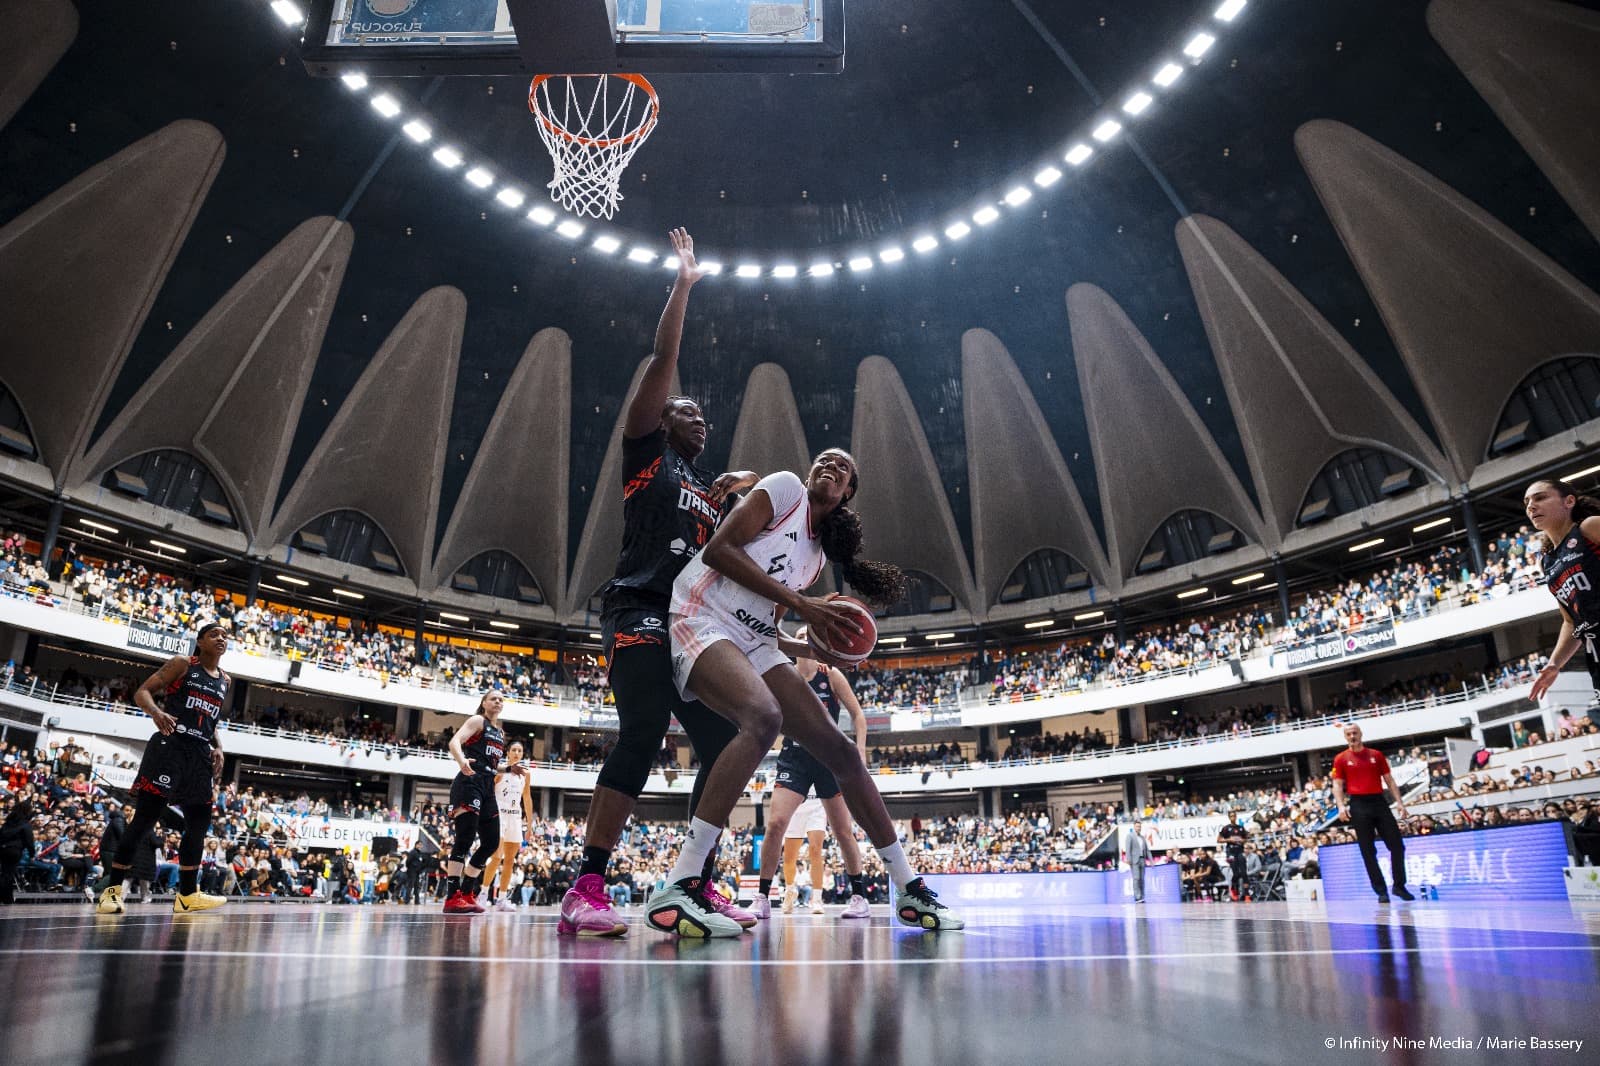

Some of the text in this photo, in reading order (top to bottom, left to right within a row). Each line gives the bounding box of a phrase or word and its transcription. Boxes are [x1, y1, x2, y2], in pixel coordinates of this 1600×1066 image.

[128, 627, 190, 657] TRIBUNE OUEST
[301, 825, 329, 839] VILLE
[334, 829, 348, 840] DE
[1158, 829, 1185, 840] VILLE
[1190, 826, 1203, 838] DE
